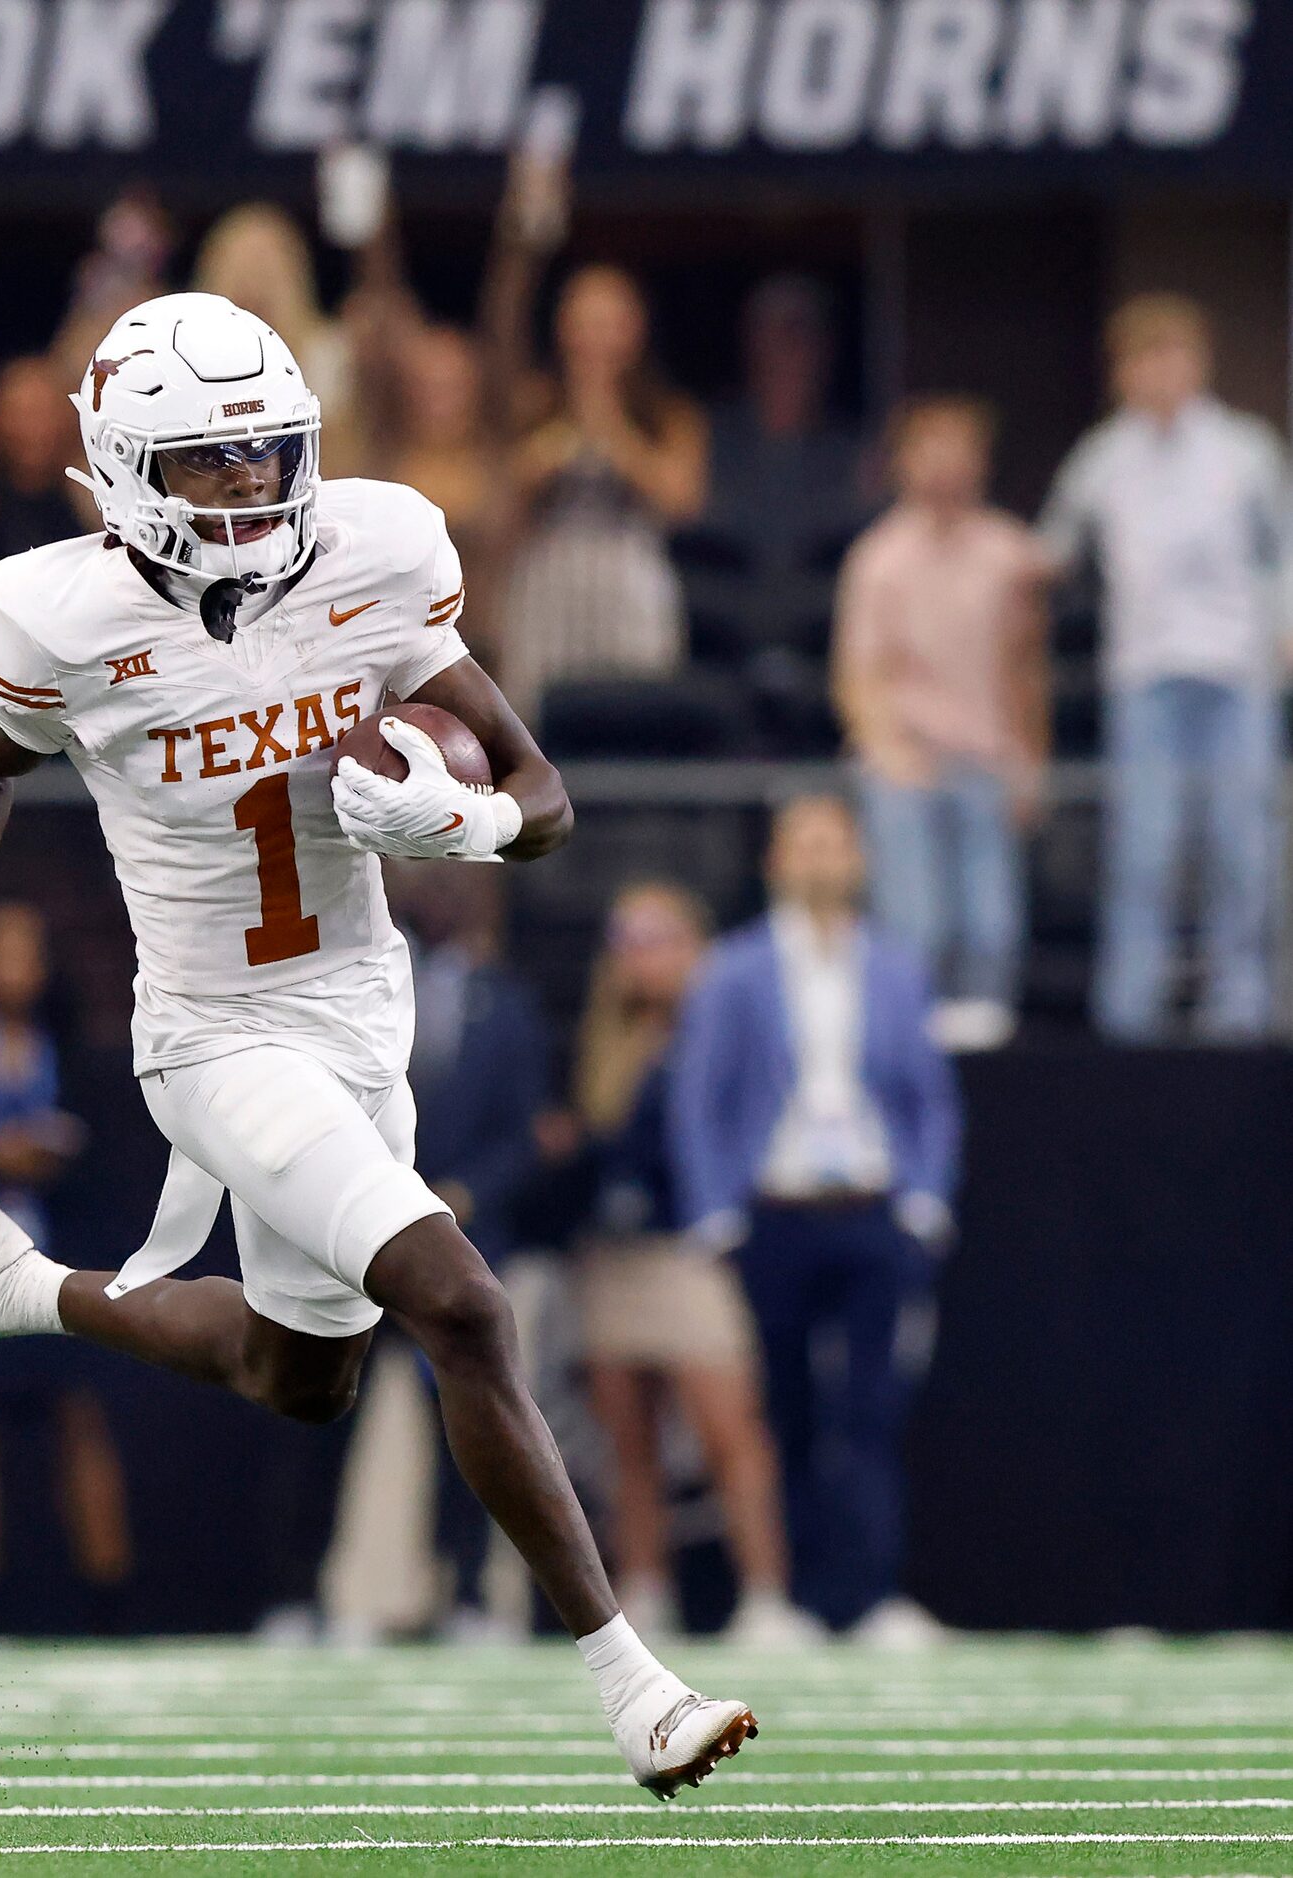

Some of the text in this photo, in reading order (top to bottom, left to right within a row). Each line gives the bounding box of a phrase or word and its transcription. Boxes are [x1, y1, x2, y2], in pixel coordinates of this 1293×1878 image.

[622, 0, 1254, 150] HORNS
[222, 399, 265, 417] HORNS
[104, 648, 159, 686] XII
[147, 680, 363, 783] TEXAS
[233, 771, 320, 967] 1
